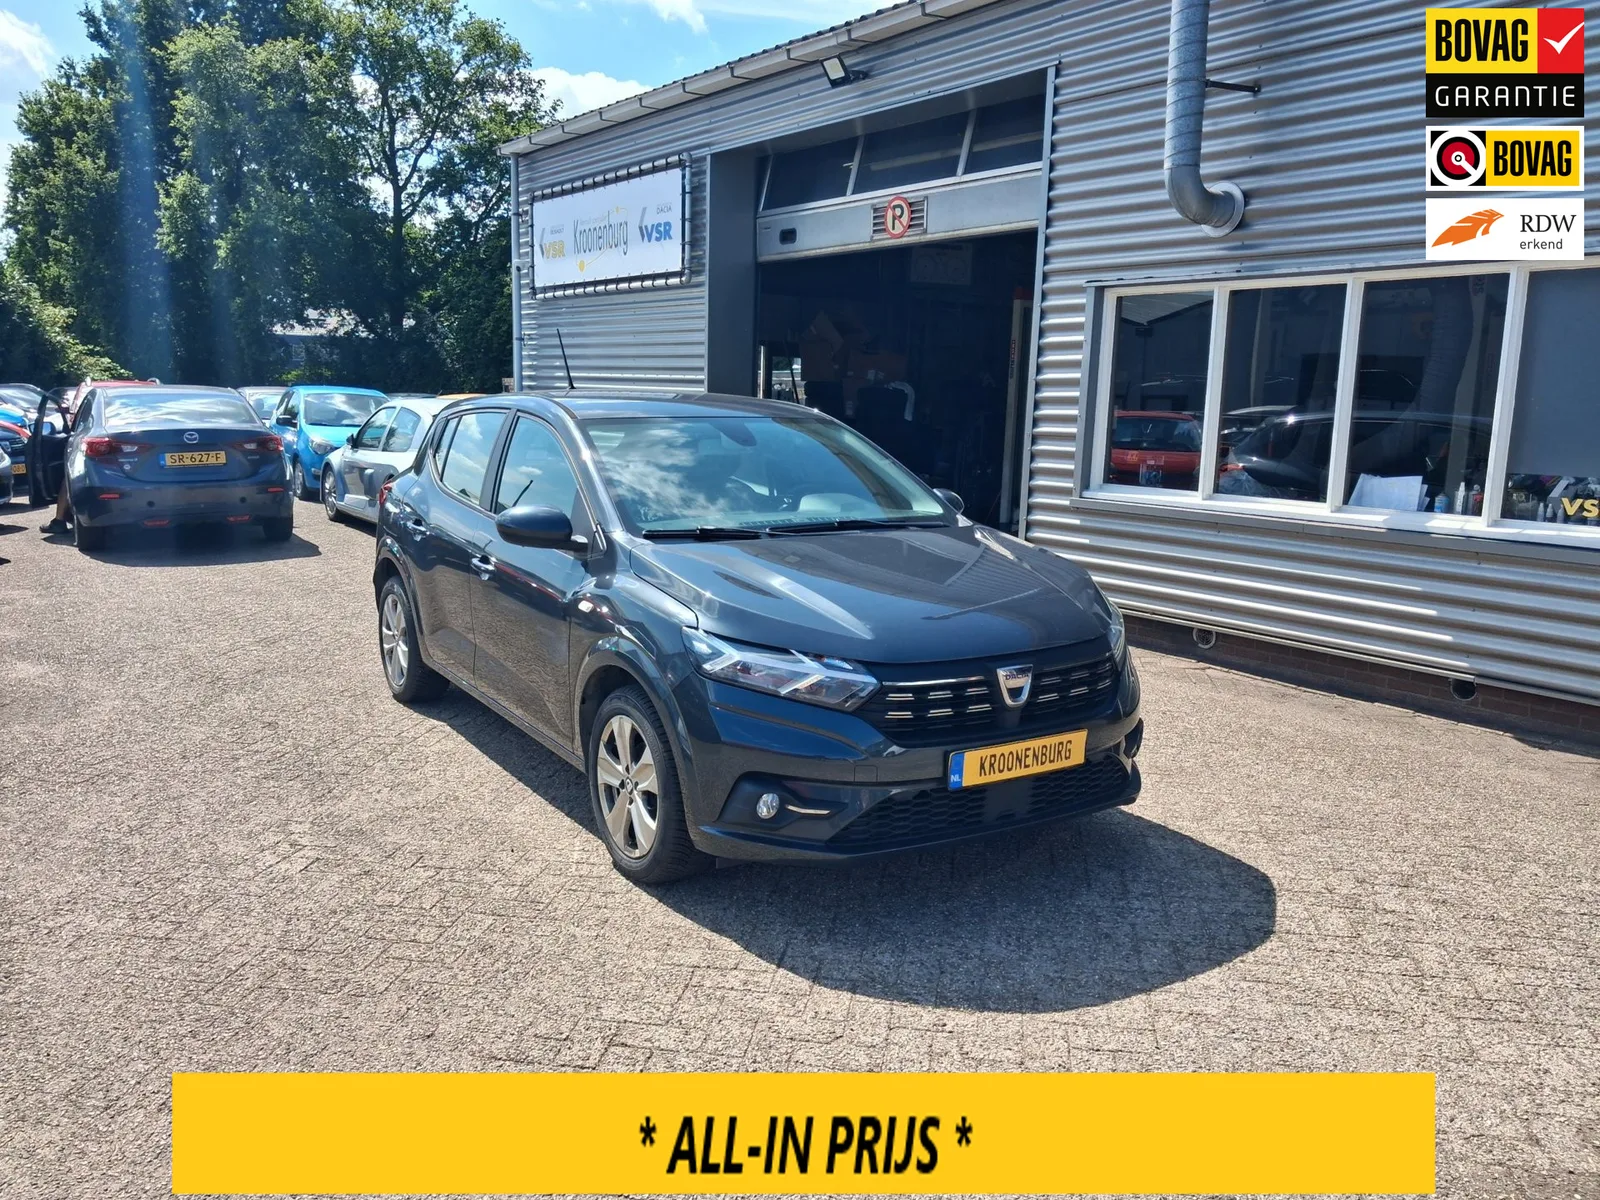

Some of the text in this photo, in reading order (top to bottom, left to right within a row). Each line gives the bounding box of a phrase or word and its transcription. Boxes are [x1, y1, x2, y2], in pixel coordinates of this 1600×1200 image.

[573, 210, 629, 256] Kroonenburg
[644, 221, 673, 243] VSR
[544, 240, 565, 260] VSR
[170, 452, 221, 464] SR-627-F
[1005, 672, 1029, 681] DACIA
[979, 740, 1073, 778] KROONENBURG
[950, 774, 962, 783] NL
